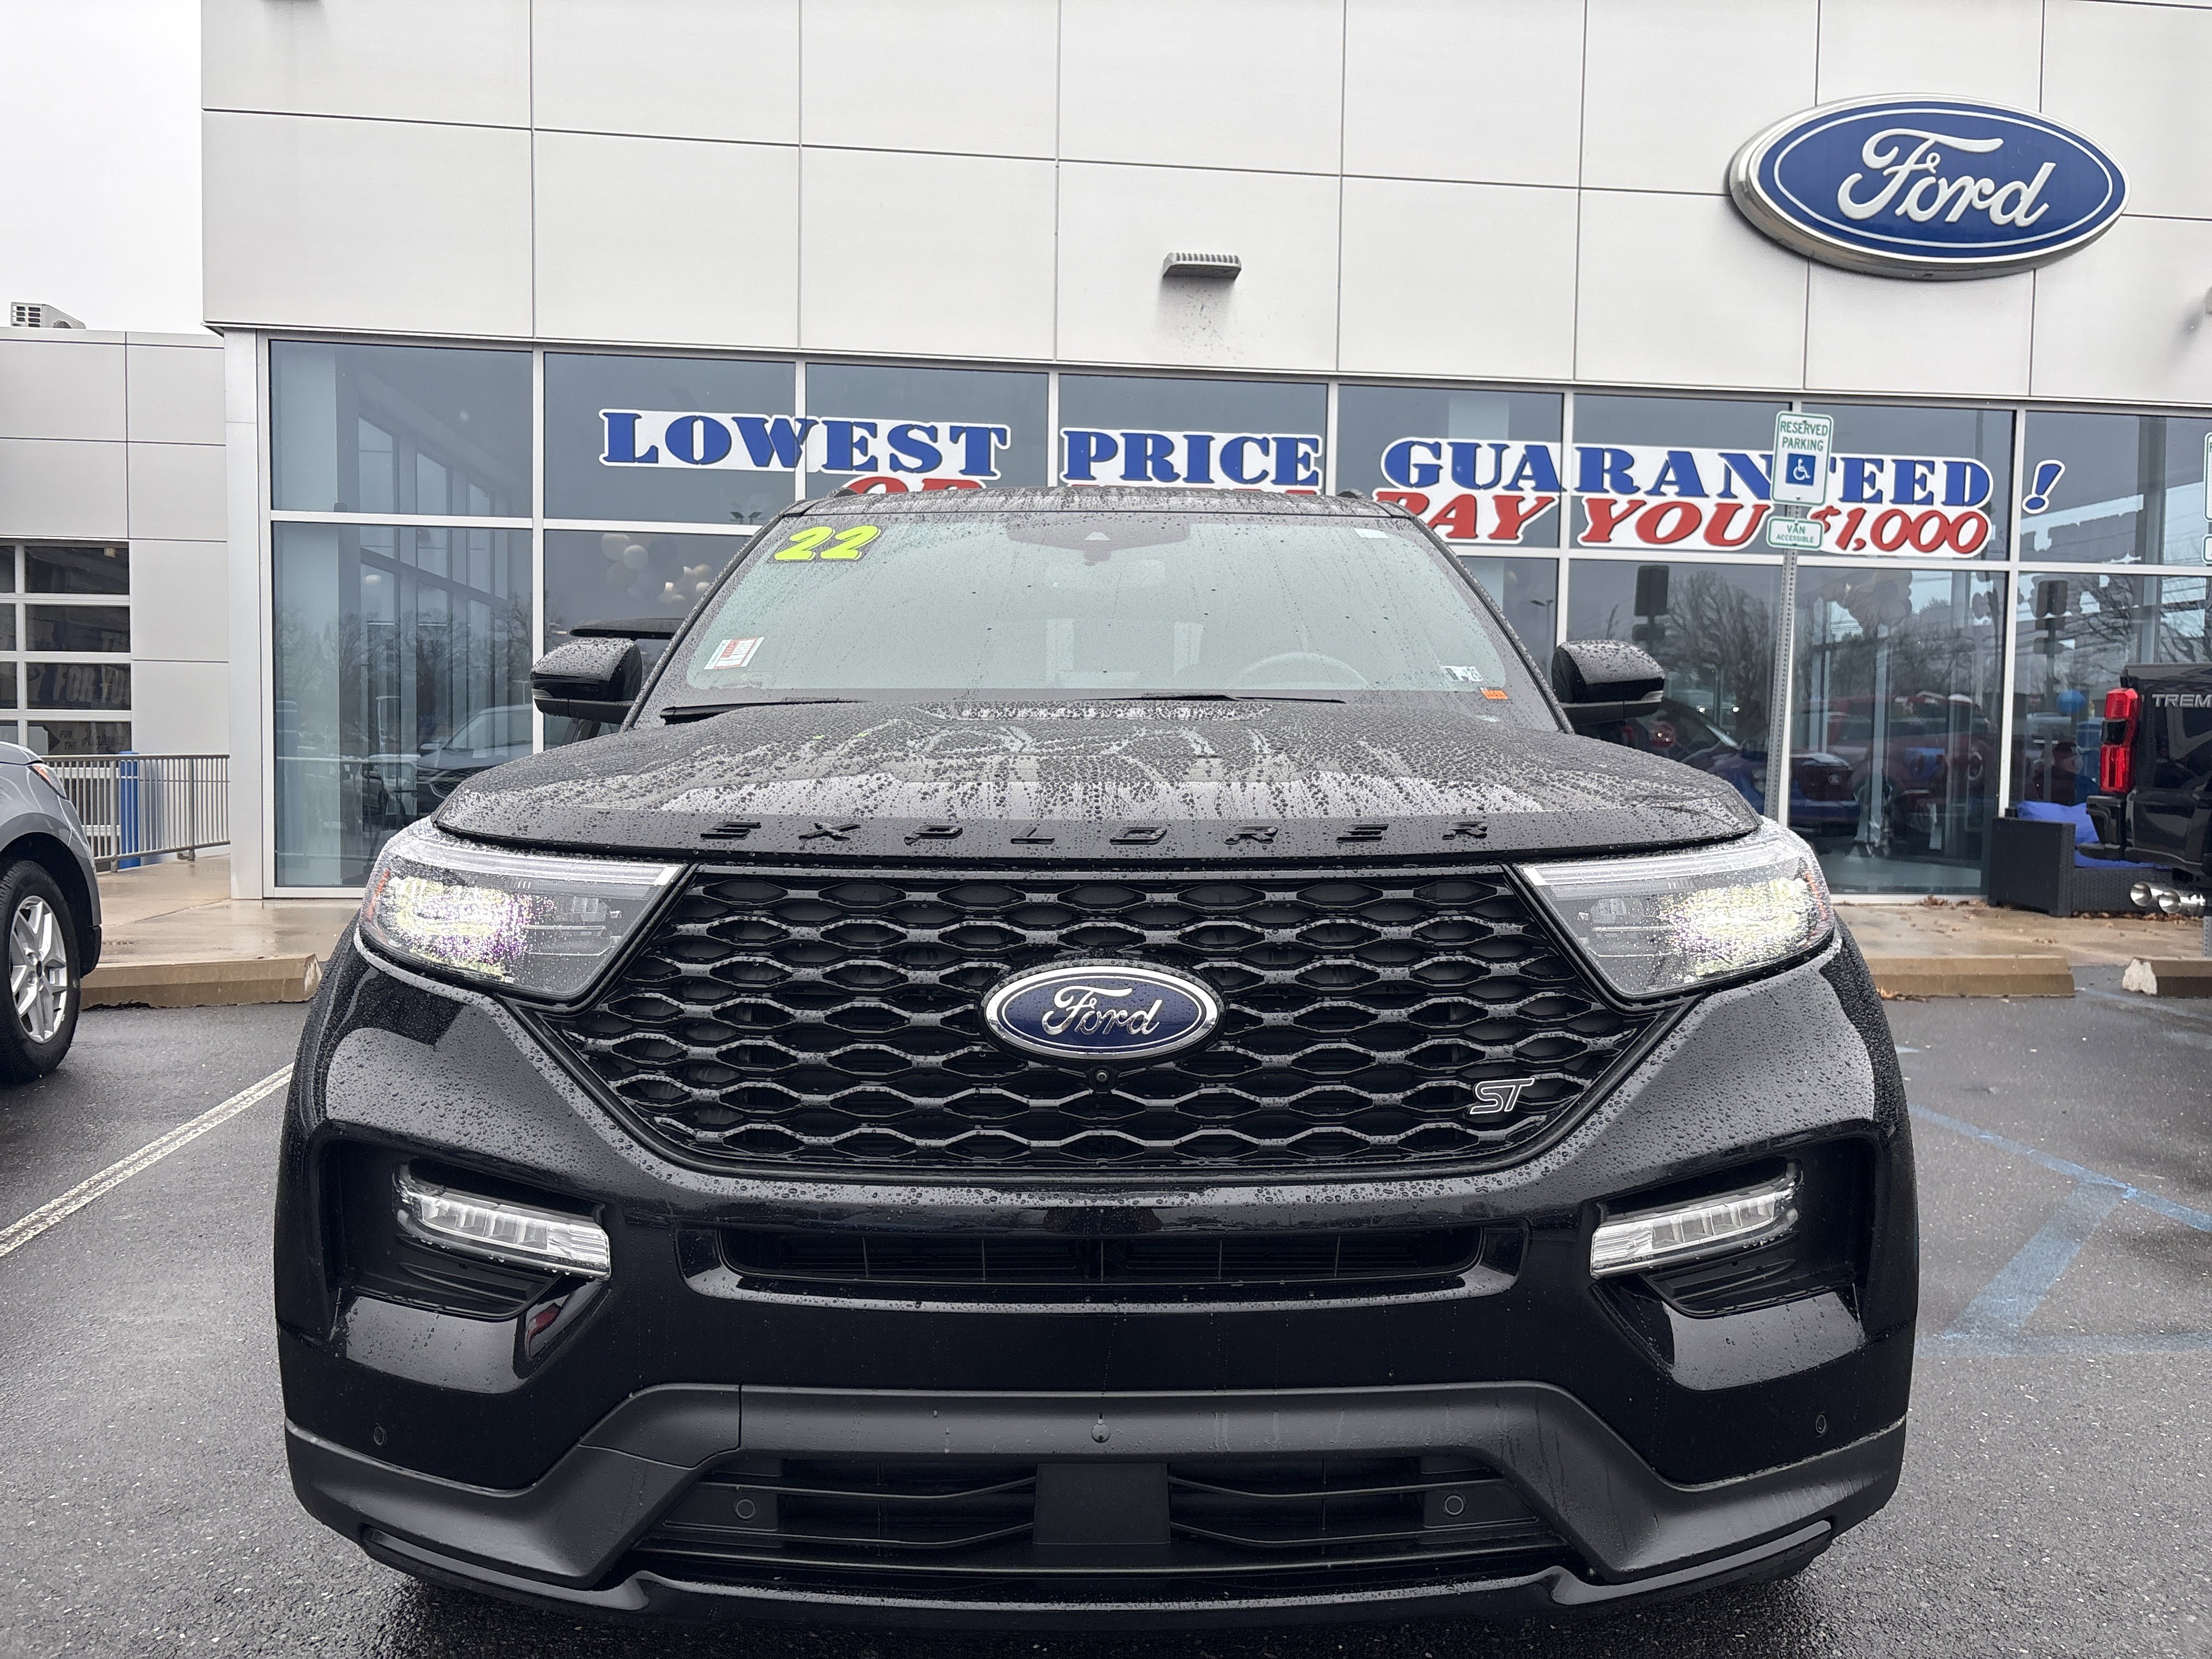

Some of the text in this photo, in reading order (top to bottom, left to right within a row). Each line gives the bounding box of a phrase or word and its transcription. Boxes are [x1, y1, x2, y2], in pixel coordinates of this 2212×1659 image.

[1838, 128, 2056, 227] Ford
[1780, 421, 1828, 437] RESERVED
[1782, 437, 1824, 452] PARKING
[602, 412, 1007, 477] LOWEST
[1063, 430, 1319, 486] PRICE
[1384, 441, 1990, 506] GUARANEED
[774, 524, 881, 561] 22
[1581, 498, 1771, 547] YOU
[1810, 505, 1989, 554] $1,000
[1776, 534, 1815, 544] ACCESSIBLE
[1787, 524, 1805, 534] VAN
[700, 821, 1489, 845] EXPLORER
[1042, 985, 1163, 1036] Ford
[1470, 1078, 1535, 1114] ST
